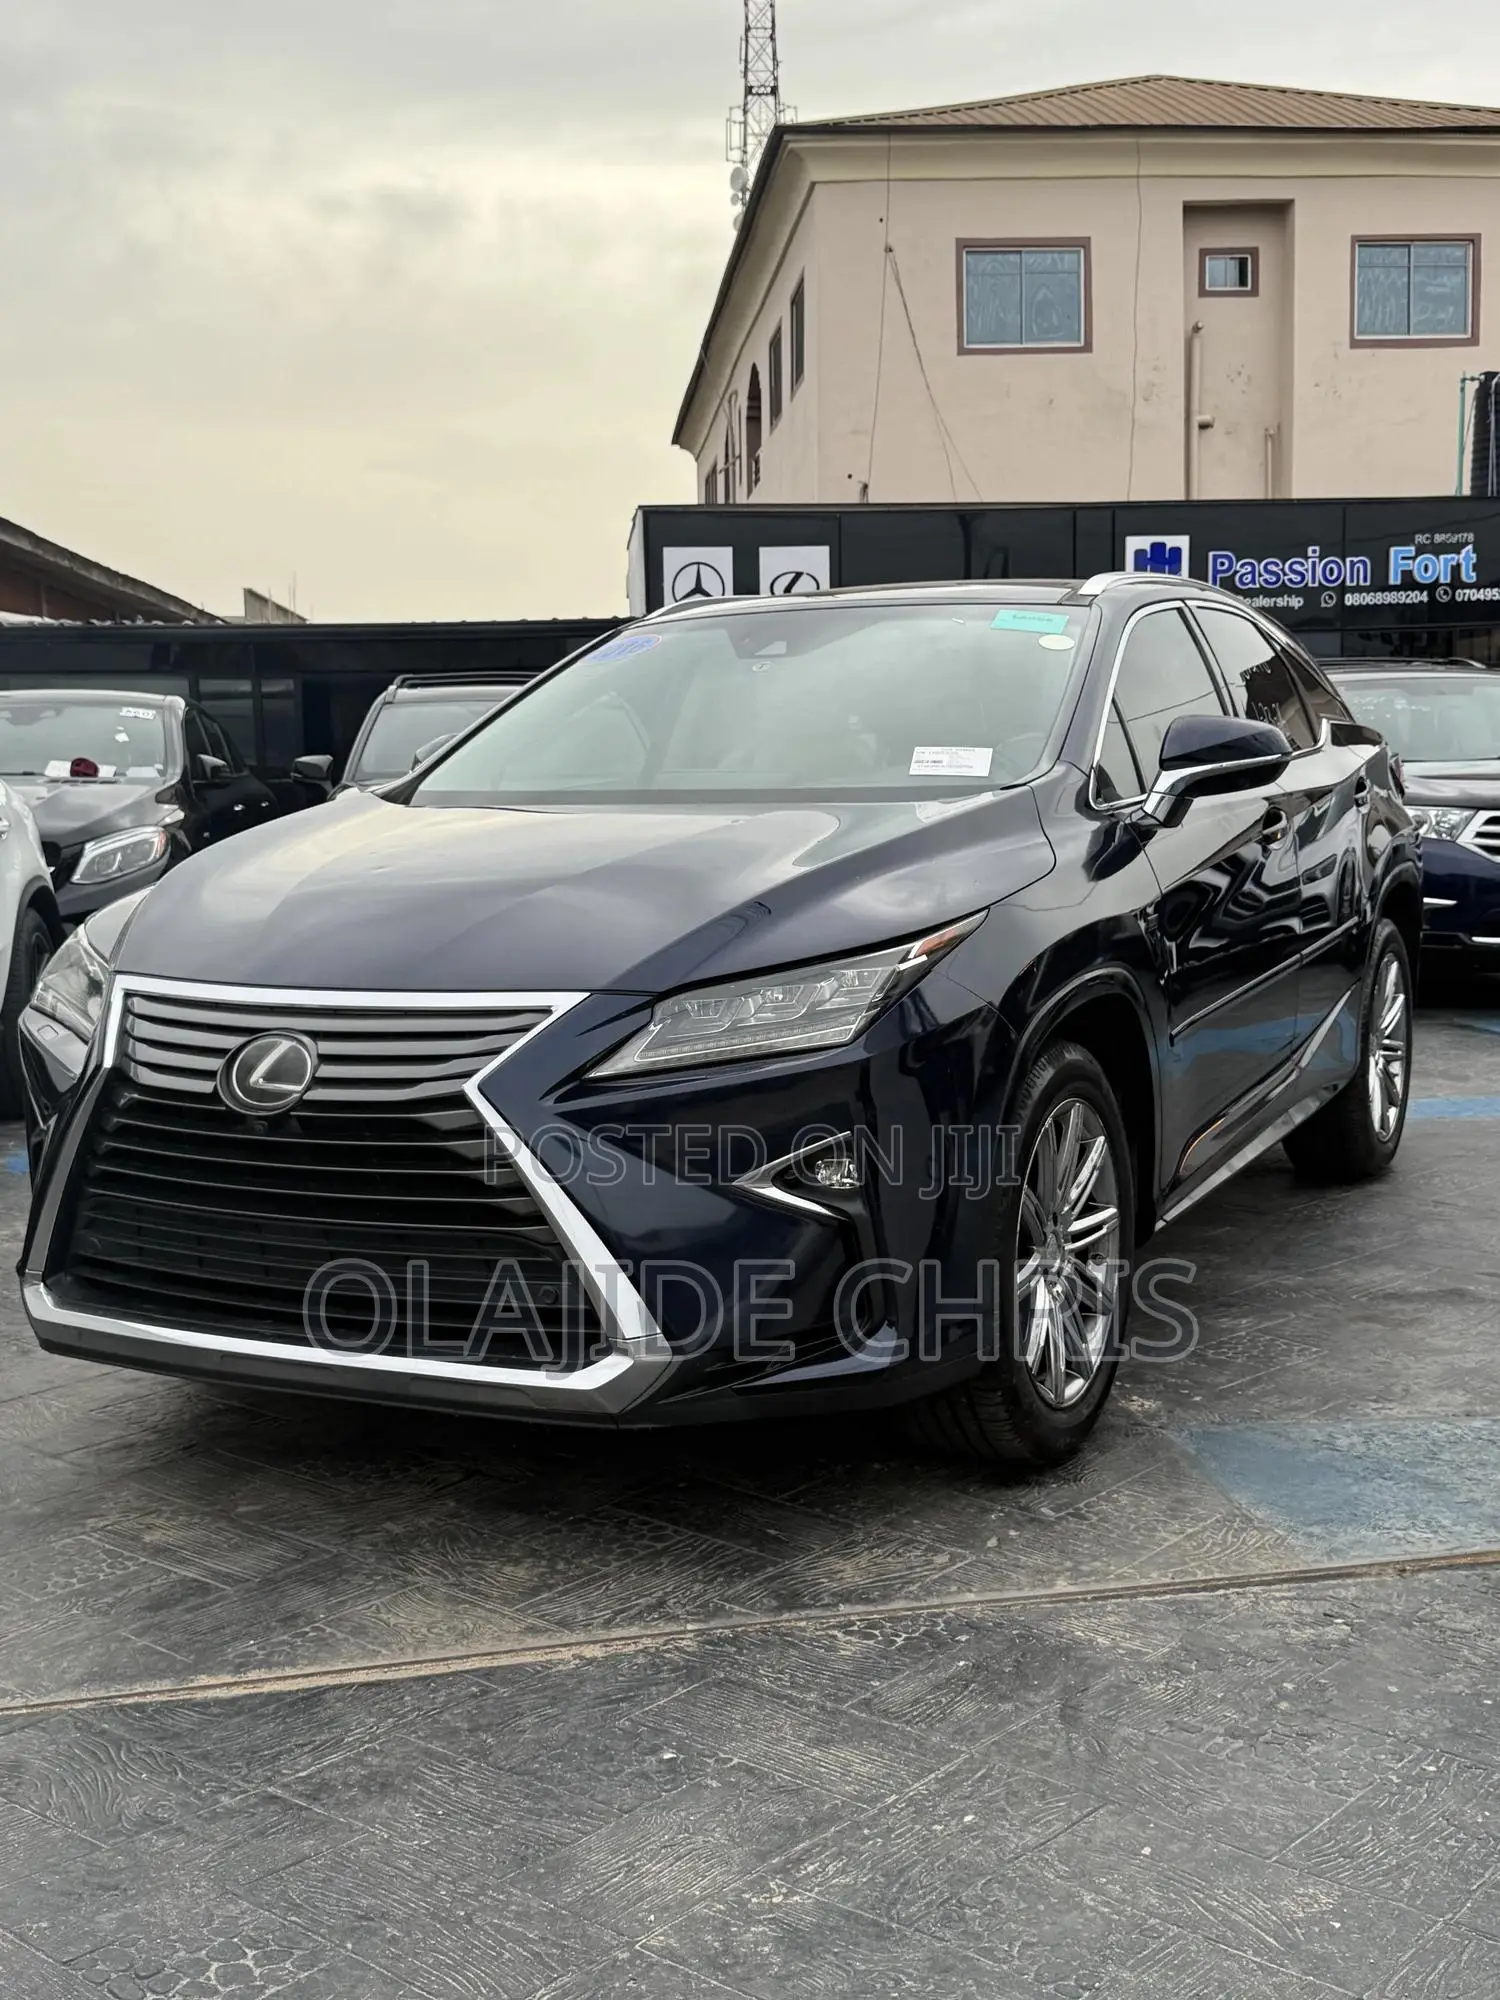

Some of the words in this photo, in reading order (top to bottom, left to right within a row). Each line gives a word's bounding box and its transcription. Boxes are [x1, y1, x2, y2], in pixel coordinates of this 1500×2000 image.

[1415, 534, 1431, 544] RC
[1208, 546, 1370, 588] Passion
[1389, 545, 1476, 585] Fort
[1244, 594, 1304, 610] ealership
[1455, 588, 1500, 602] 070495
